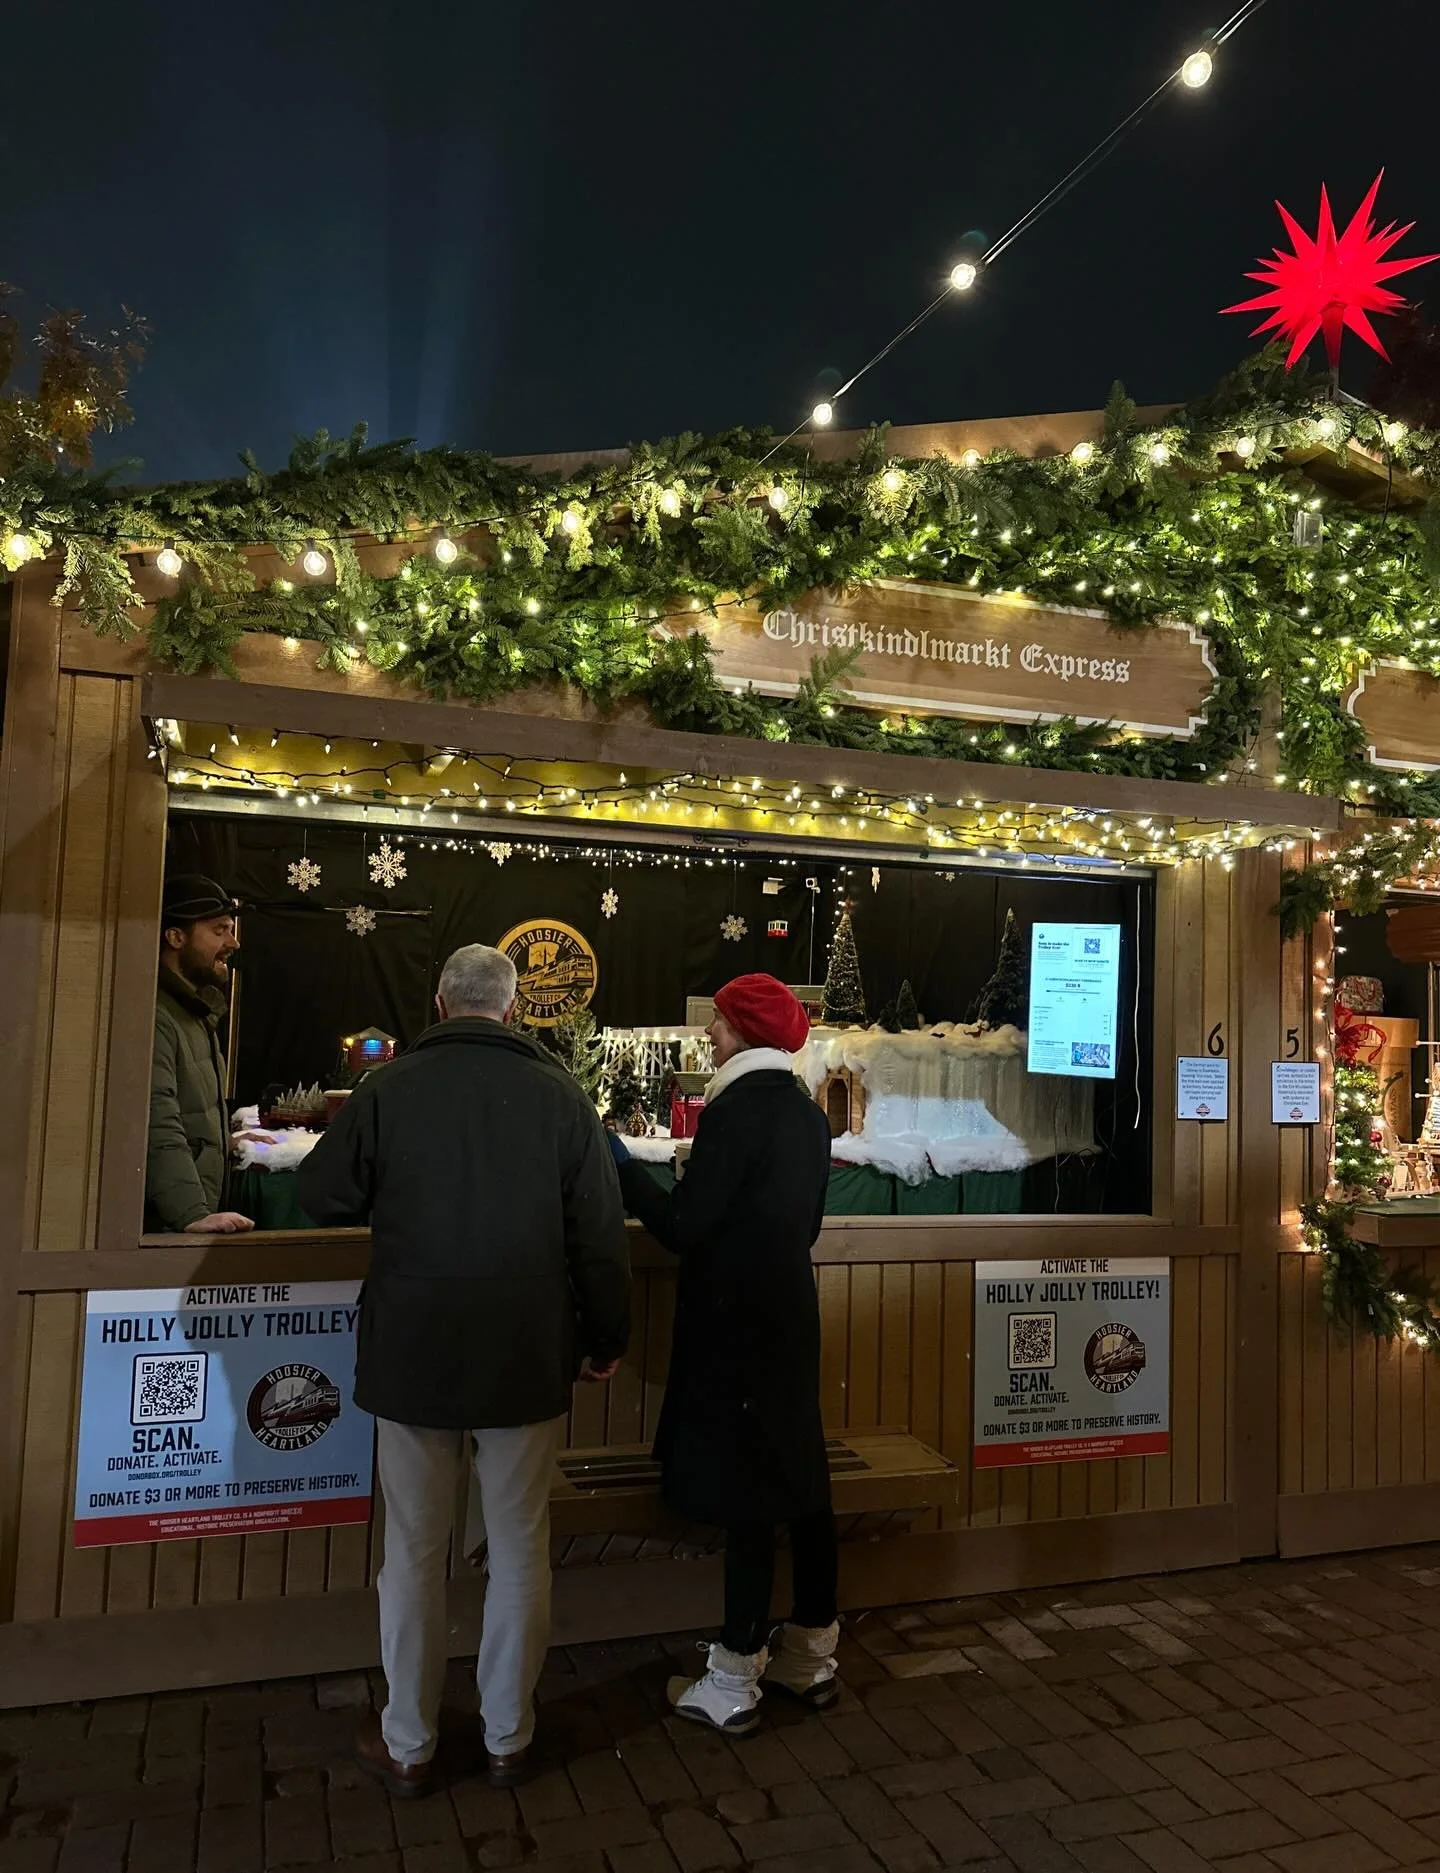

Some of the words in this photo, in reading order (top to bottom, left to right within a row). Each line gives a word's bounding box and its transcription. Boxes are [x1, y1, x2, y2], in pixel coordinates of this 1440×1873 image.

[762, 609, 1011, 669] Christkindlmarkt
[1020, 644, 1131, 684] Express
[518, 929, 574, 948] HOOSIER
[1207, 1022, 1225, 1056] 6
[1286, 1027, 1300, 1058] 5
[1040, 1259, 1087, 1274] ACTIVATE
[1089, 1259, 1109, 1273] THE
[186, 1286, 257, 1305] ACTIVATE
[262, 1285, 291, 1302] THE
[986, 1283, 1035, 1304] HOLLY
[1040, 1282, 1086, 1302] JOLLY
[1092, 1280, 1160, 1300] TROLLEY!
[102, 1317, 176, 1343] HOLLY
[184, 1314, 255, 1340] JOLLY
[264, 1310, 359, 1337] TROLLEY
[1095, 1324, 1132, 1340] HOOSIER
[265, 1365, 321, 1384] HOOSIER
[1010, 1372, 1054, 1393] SCAN.
[1090, 1370, 1138, 1393] HEARTLAND
[994, 1395, 1028, 1407] DONATE.
[1030, 1392, 1069, 1405] ACTIVATE.
[255, 1422, 328, 1449] HEARTLAND
[984, 1422, 1017, 1436] DONATE
[1019, 1421, 1030, 1435] $3
[1032, 1420, 1043, 1433] OR
[1045, 1419, 1069, 1432] MORE
[1071, 1418, 1081, 1430] TO
[1084, 1415, 1124, 1429] PRESERVE
[1126, 1412, 1161, 1426] HISTORY.
[132, 1426, 200, 1453] SCAN.
[107, 1454, 159, 1471] DONATE.
[163, 1450, 222, 1467] ACTIVATE.
[89, 1490, 140, 1508] DONATE
[144, 1489, 161, 1505] $3
[165, 1487, 181, 1501] OR
[186, 1484, 221, 1500] MORE
[225, 1482, 240, 1497] TO
[244, 1478, 305, 1496] PRESERVE
[308, 1473, 360, 1491] HISTORY.
